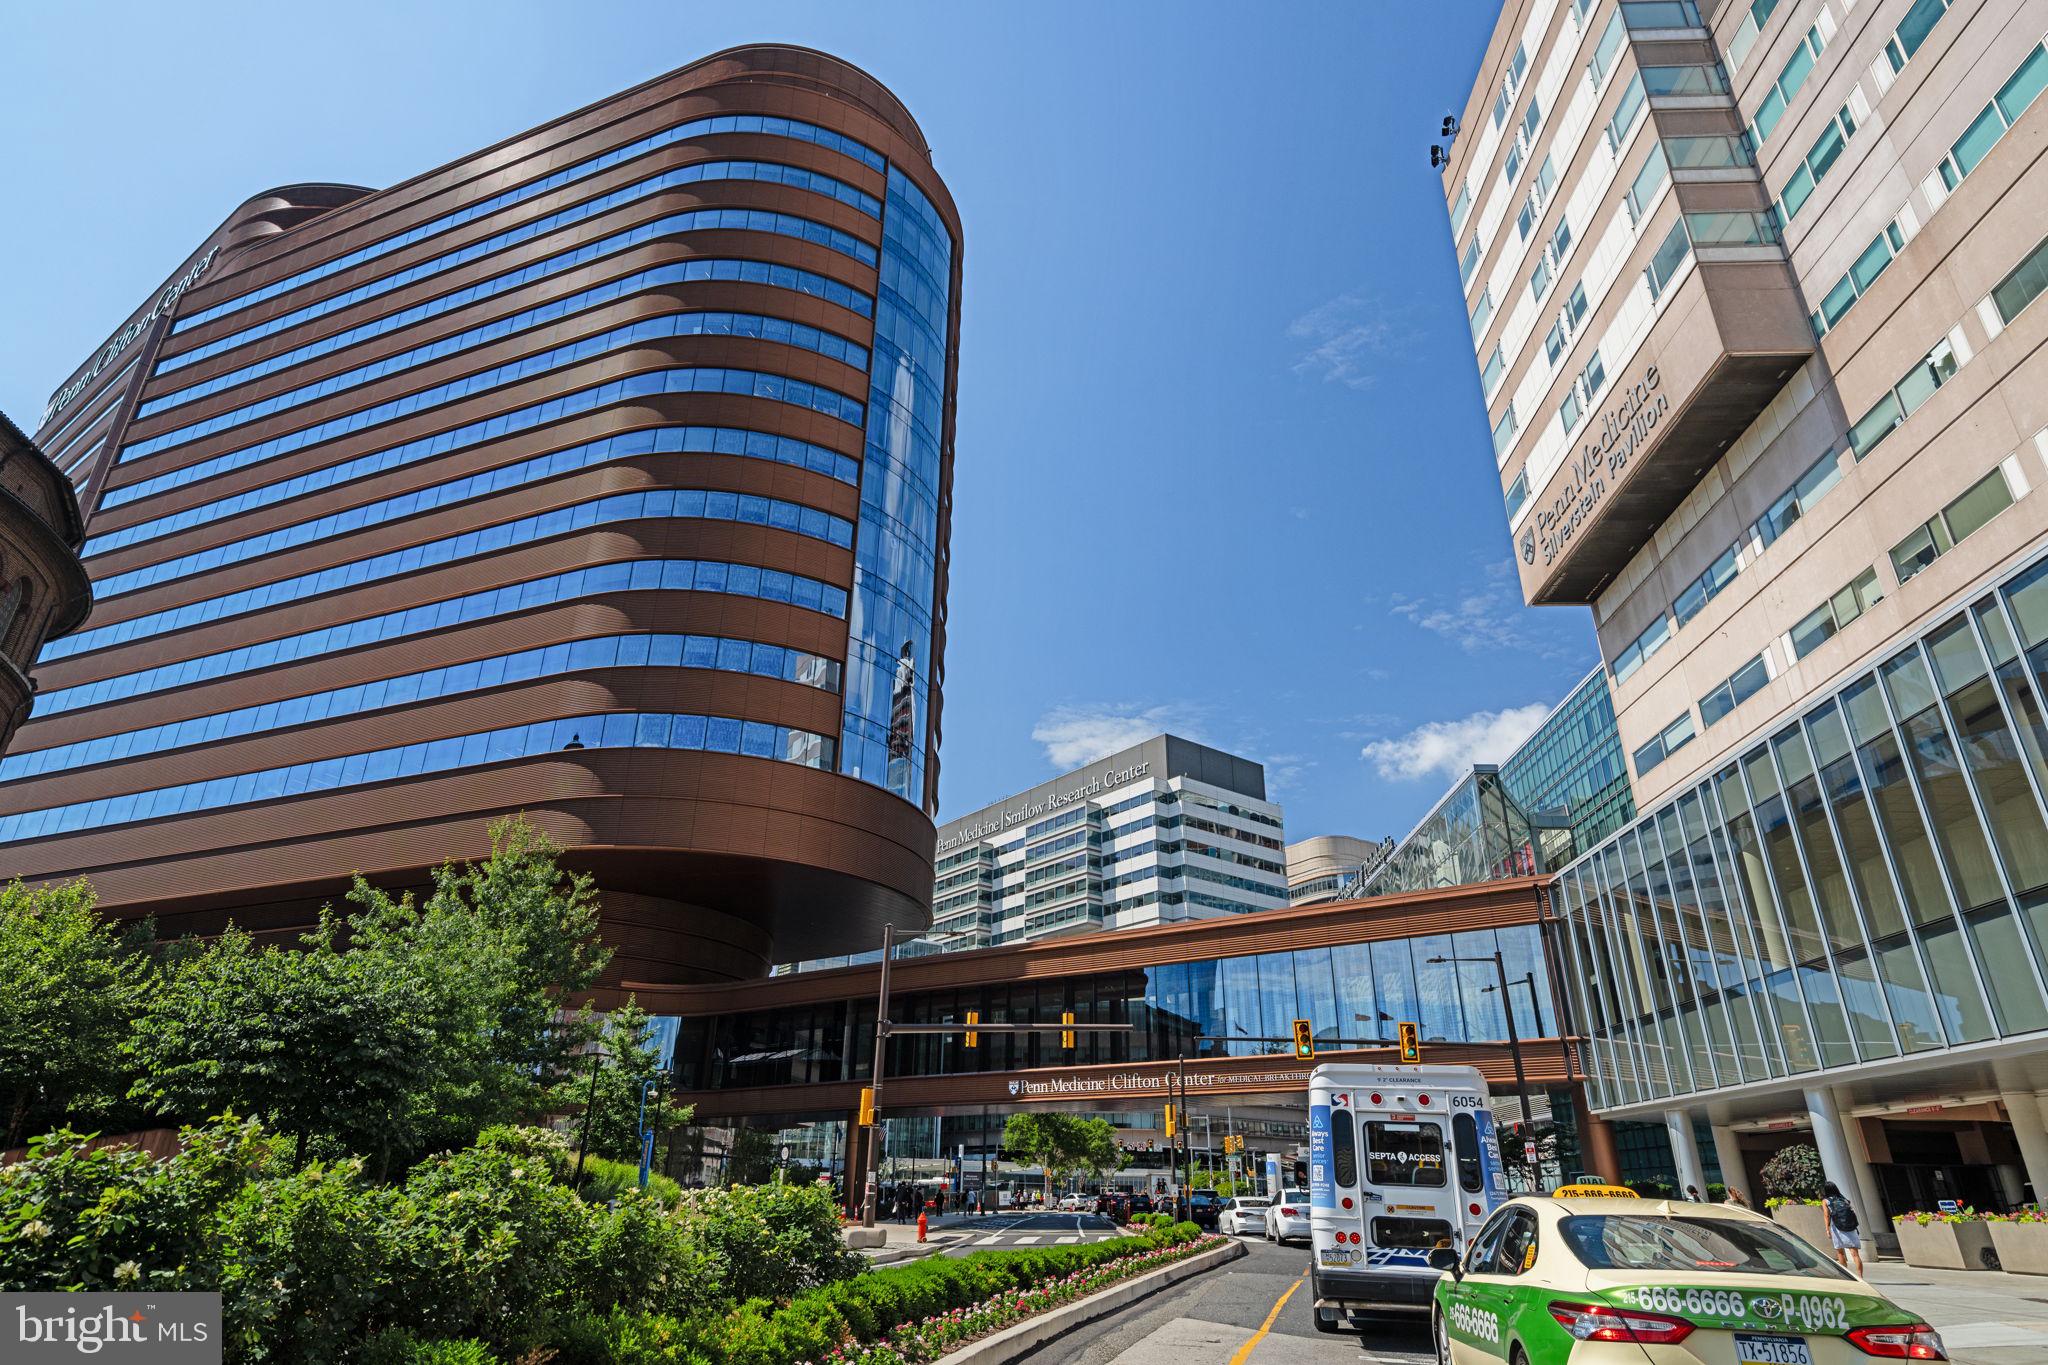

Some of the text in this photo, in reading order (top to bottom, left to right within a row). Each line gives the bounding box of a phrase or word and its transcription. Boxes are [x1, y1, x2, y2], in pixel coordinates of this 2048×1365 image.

[94, 313, 151, 377] Clifton
[151, 245, 220, 320] Center
[1536, 364, 1661, 544] Penn Medicine
[1544, 394, 1668, 566] Silverstein Pavilion
[936, 761, 1150, 854] Penn Medicine Smilow Research Center
[1021, 1080, 1048, 1094] Penn
[1051, 1076, 1105, 1093] Medicine
[1112, 1073, 1159, 1090] Clifton
[1229, 1074, 1263, 1083] MEDICAL
[1452, 1096, 1484, 1108] 6054
[1369, 1152, 1441, 1162] SEPTA ACCESS
[1580, 1177, 1604, 1185] DIAL
[1623, 1286, 1850, 1330] 215-666-6666 P-0962
[1751, 1335, 1789, 1343] PENNSYLVANIA
